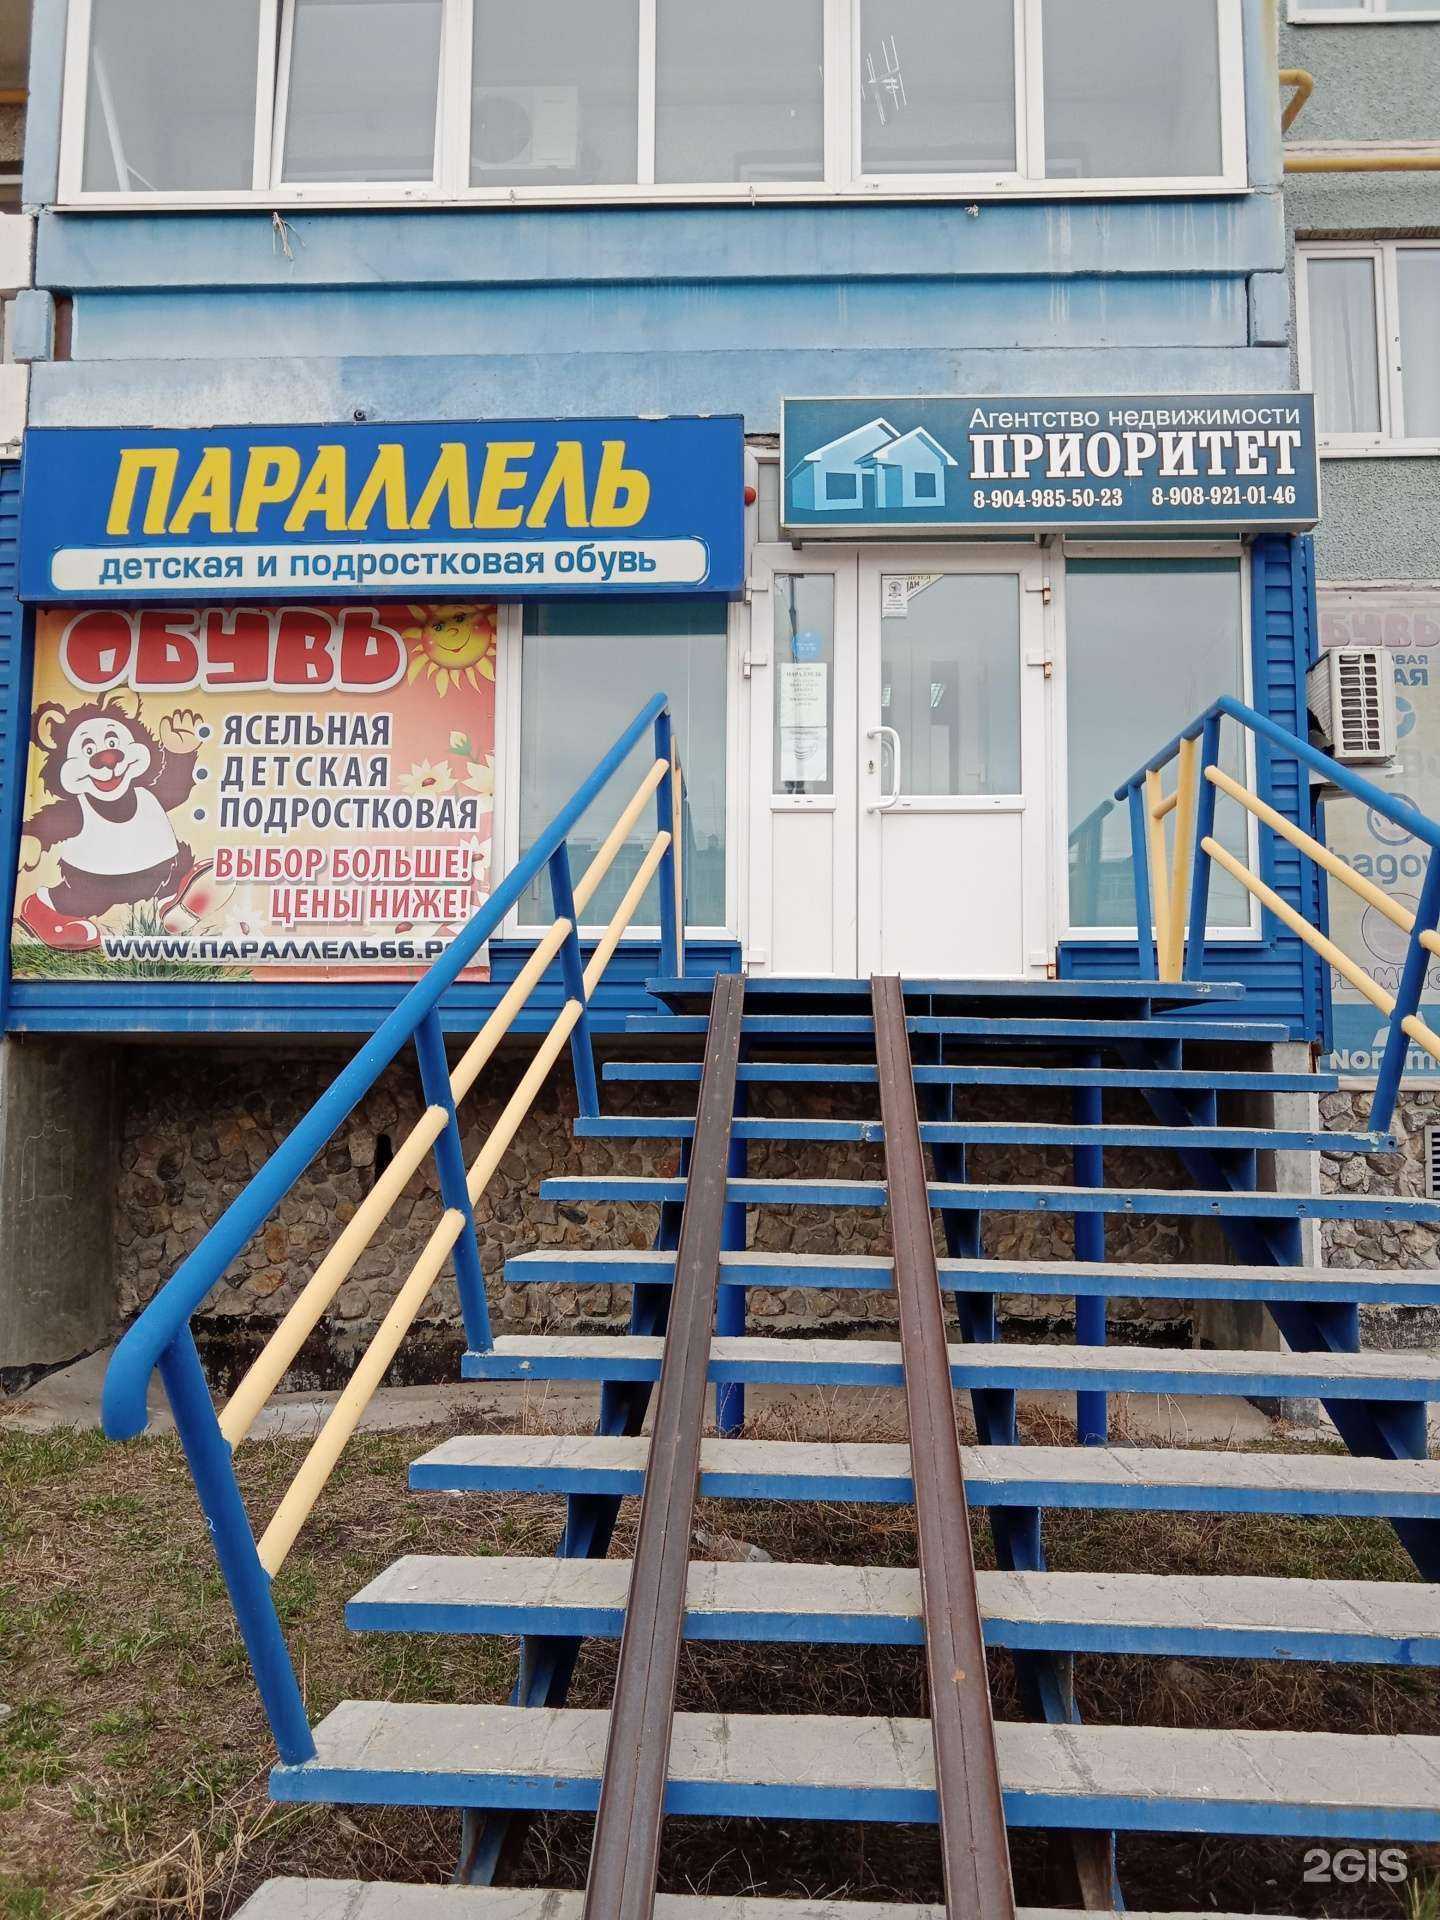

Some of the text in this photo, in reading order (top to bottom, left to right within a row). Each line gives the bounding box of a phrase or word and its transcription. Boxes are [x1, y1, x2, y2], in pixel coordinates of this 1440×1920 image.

[969, 407, 1301, 429] Агентство недвижимости
[968, 430, 1301, 480] ПРИОРИТЕТ
[106, 440, 651, 535] ПАРАЛЛЕЛЬ
[973, 485, 1296, 508] 8-904-985-50-23 8-908-921-01-46
[98, 543, 657, 585] детская и подростковая обувь
[61, 608, 407, 691] ОБУВЬ
[1392, 654, 1428, 665] ВАЯ
[223, 715, 390, 745] ЯСЕЛЬНАЯ
[220, 756, 388, 792] ДЕТСКАЯ
[219, 798, 478, 834] ПОДРОСТКОВАЯ
[215, 848, 469, 878] ВЫБОР БОЛЬШЕ!
[271, 888, 468, 924] ЦЕНЫ НИЖЕ!
[105, 939, 453, 959] WWW.ПАРАЛЛЕЛЬ66.Р
